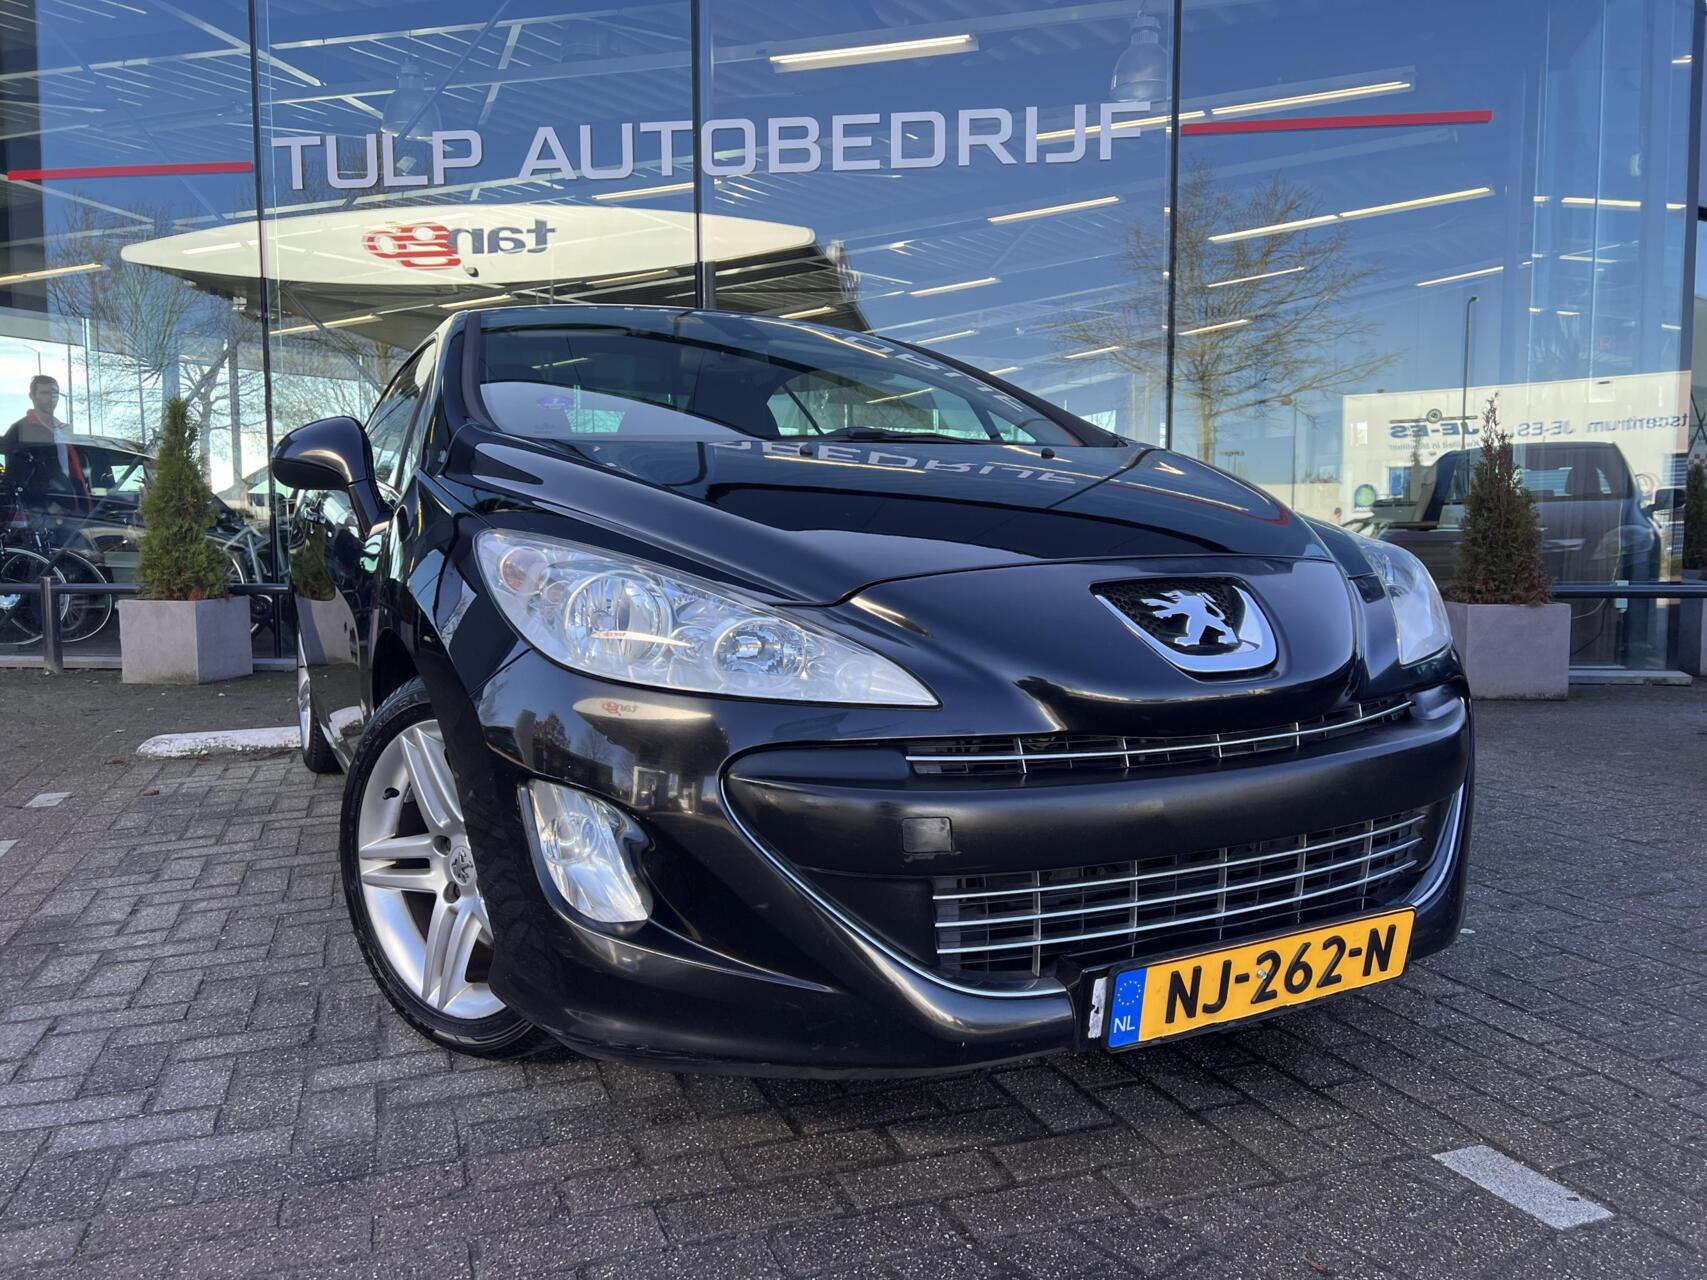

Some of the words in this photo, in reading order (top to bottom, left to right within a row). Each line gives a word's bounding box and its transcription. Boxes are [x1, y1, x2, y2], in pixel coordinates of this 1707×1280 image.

[271, 129, 483, 190] TULP
[518, 101, 1151, 181] AUTOBEDRIJF
[1113, 1015, 1136, 1034] NL
[1165, 924, 1397, 1024] NJ-262-N
